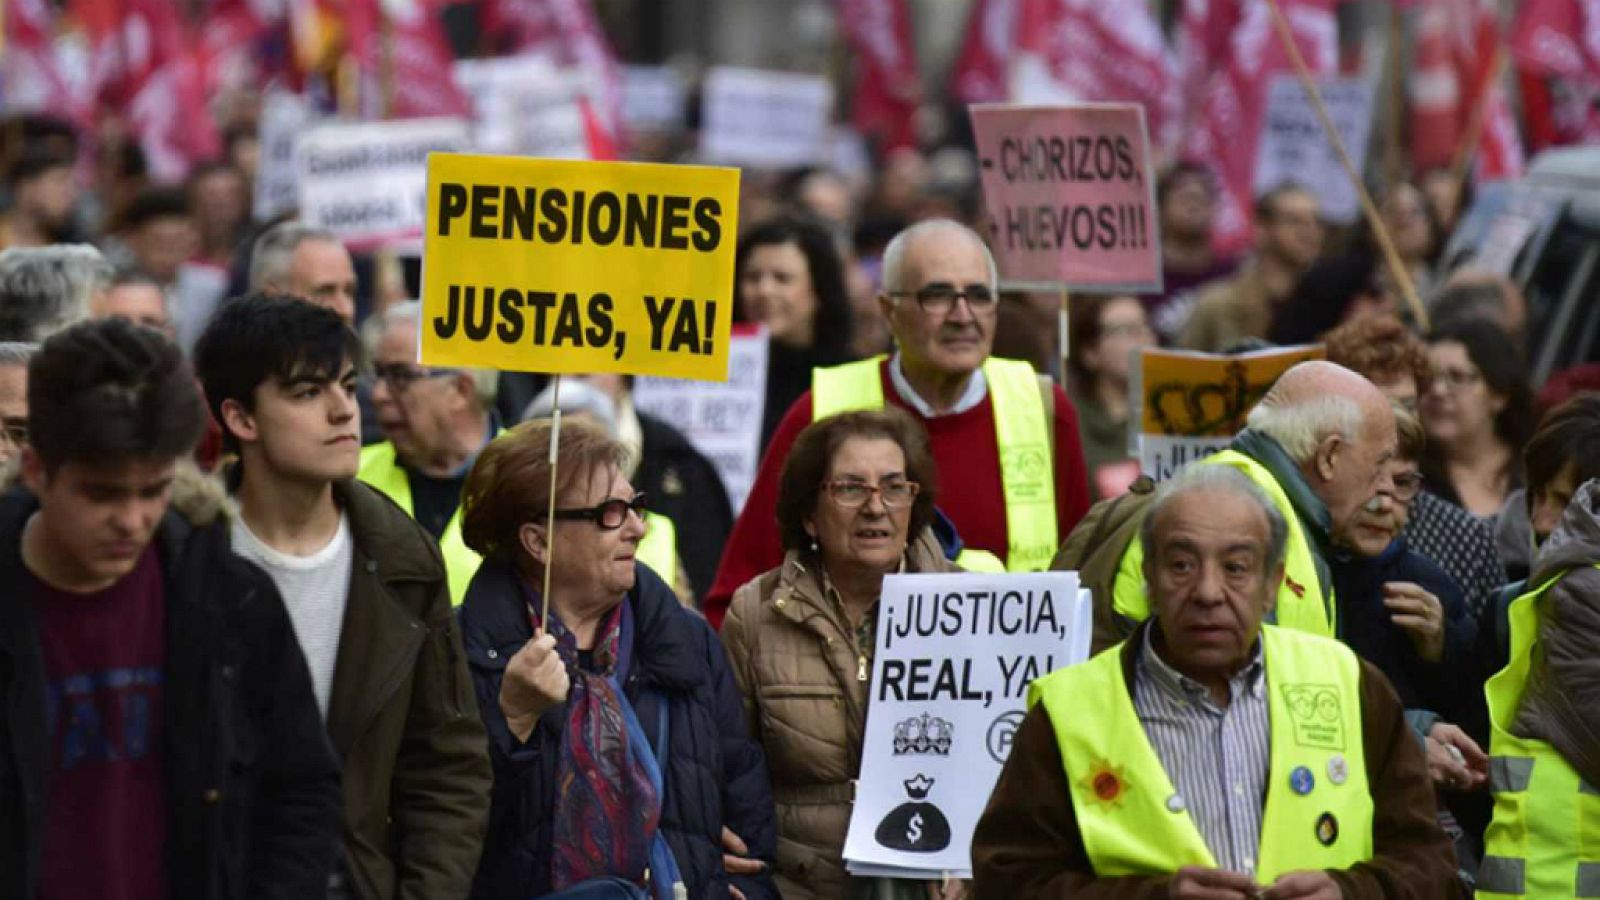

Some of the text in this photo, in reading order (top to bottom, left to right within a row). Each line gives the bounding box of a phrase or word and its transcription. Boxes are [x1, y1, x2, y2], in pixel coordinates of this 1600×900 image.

[1001, 134, 1143, 187] CHORIZOS,
[438, 182, 722, 253] PENSIONES
[1007, 203, 1148, 249] HUEVOS!!!
[433, 285, 717, 361] JUSTAS, YA!
[884, 590, 1066, 649] ¡JUSTICIA,
[878, 658, 992, 708] REAL,
